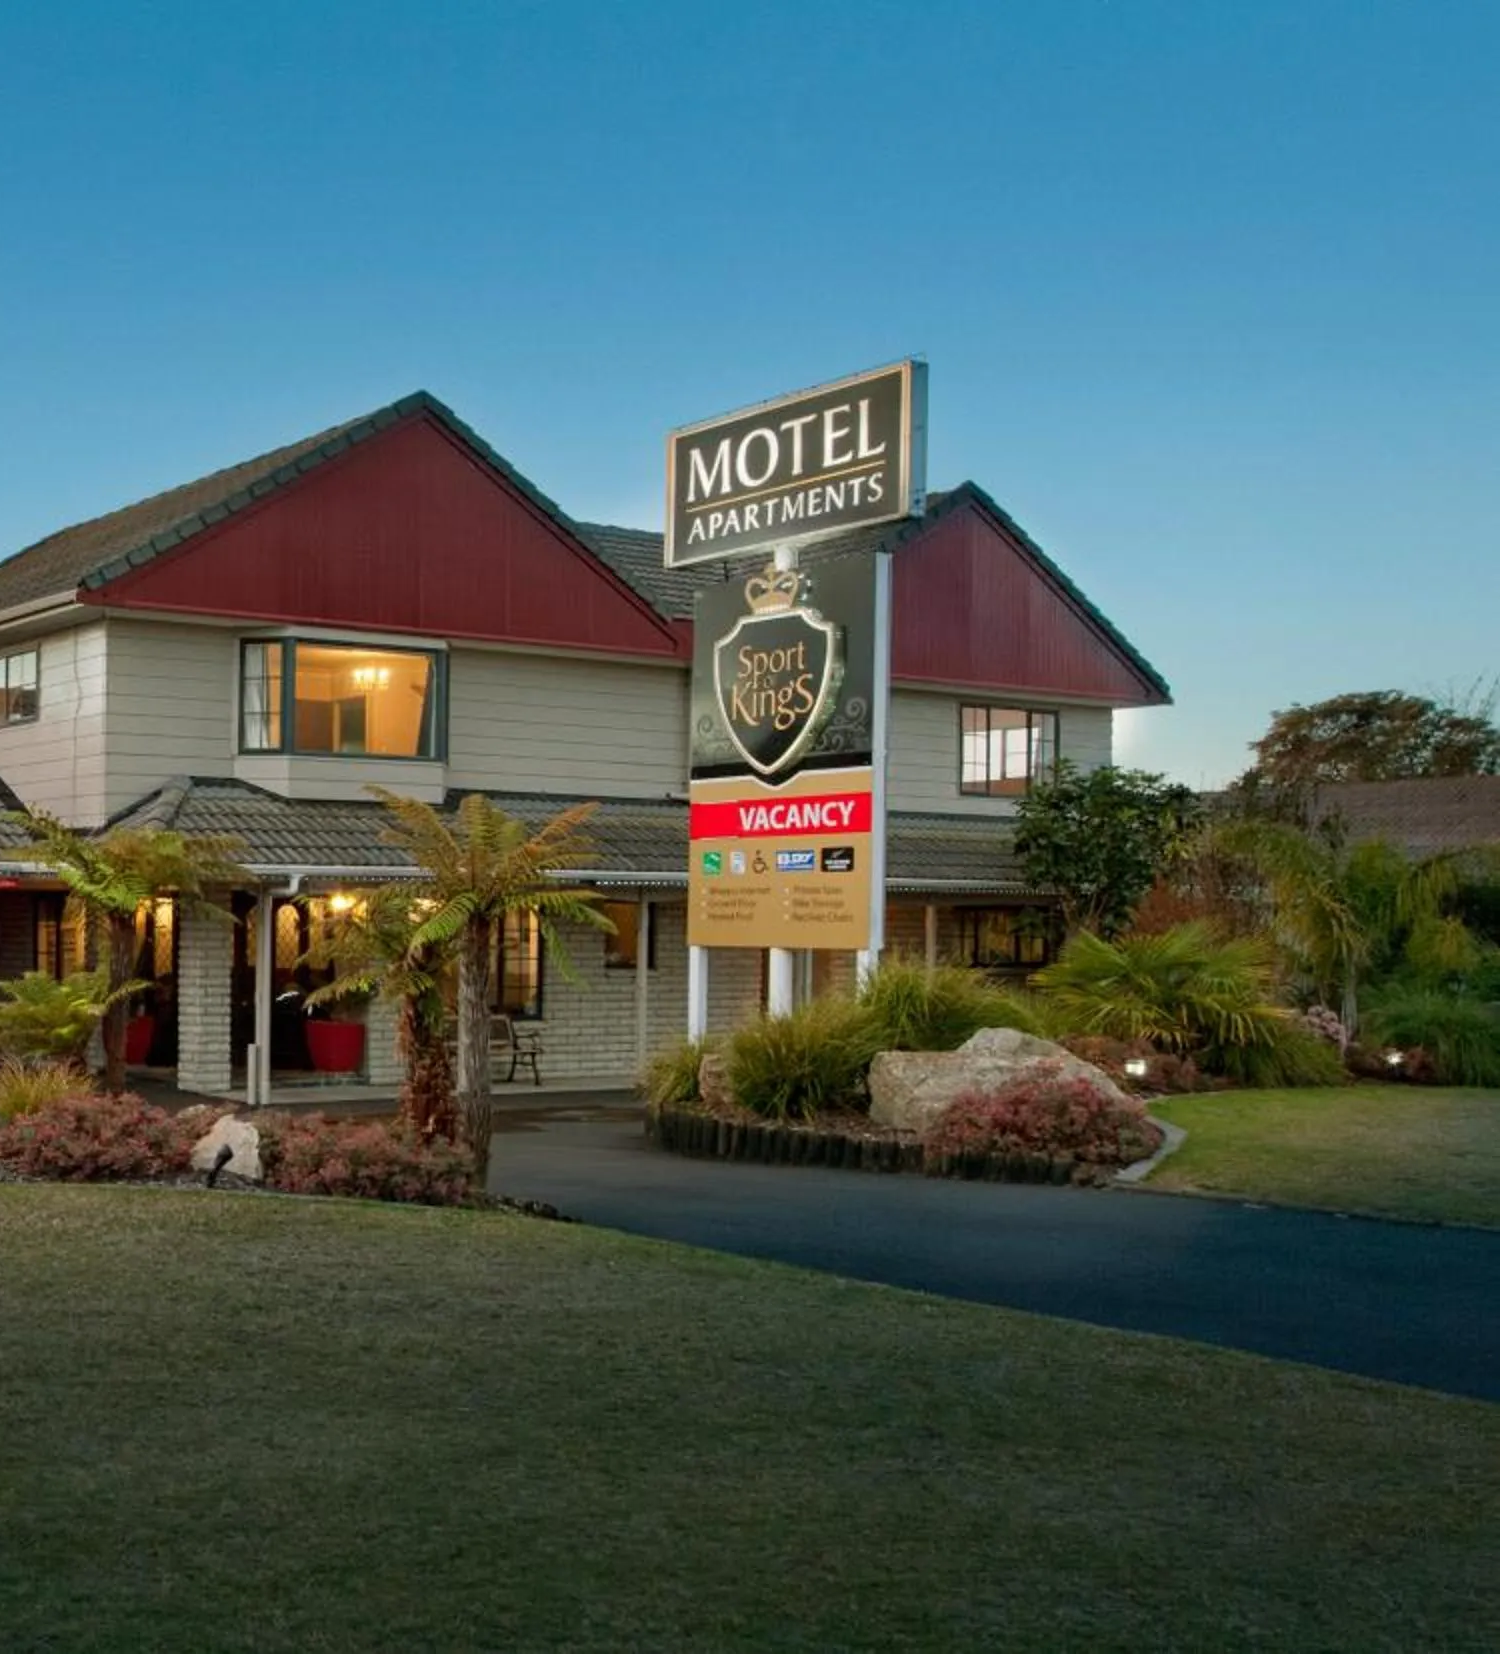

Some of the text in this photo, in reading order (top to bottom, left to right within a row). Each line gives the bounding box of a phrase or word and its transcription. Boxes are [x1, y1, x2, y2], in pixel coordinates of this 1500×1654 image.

[686, 399, 887, 503] MOTEL
[687, 472, 884, 545] APARTMENTS
[736, 640, 805, 689] Sport
[739, 800, 855, 831] VACANCY
